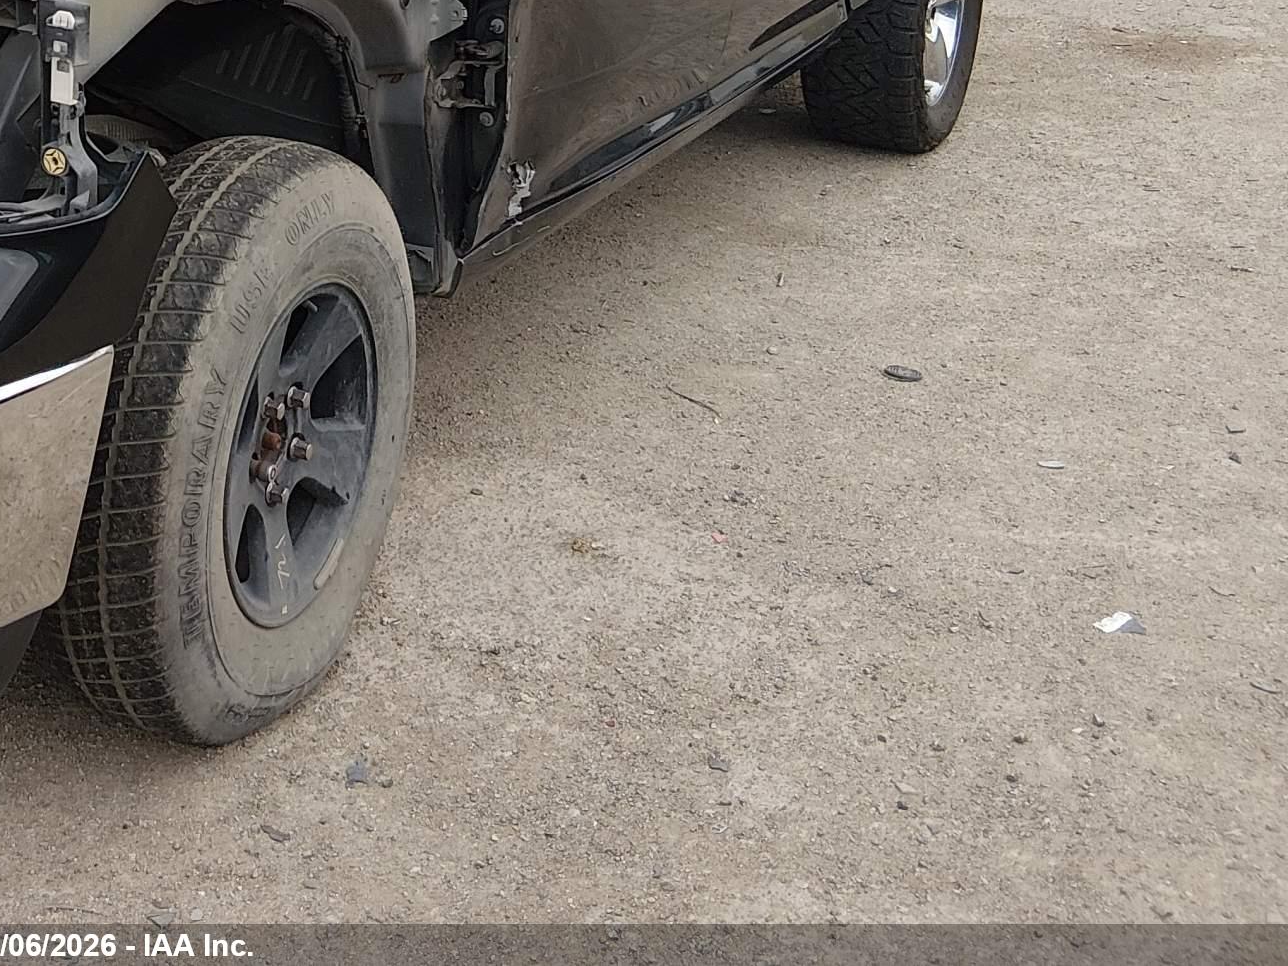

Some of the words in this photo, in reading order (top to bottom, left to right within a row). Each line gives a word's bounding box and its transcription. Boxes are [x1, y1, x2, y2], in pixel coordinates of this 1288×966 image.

[178, 368, 227, 650] TEMPORARY
[229, 266, 274, 335] USE
[284, 192, 336, 246] ONLY
